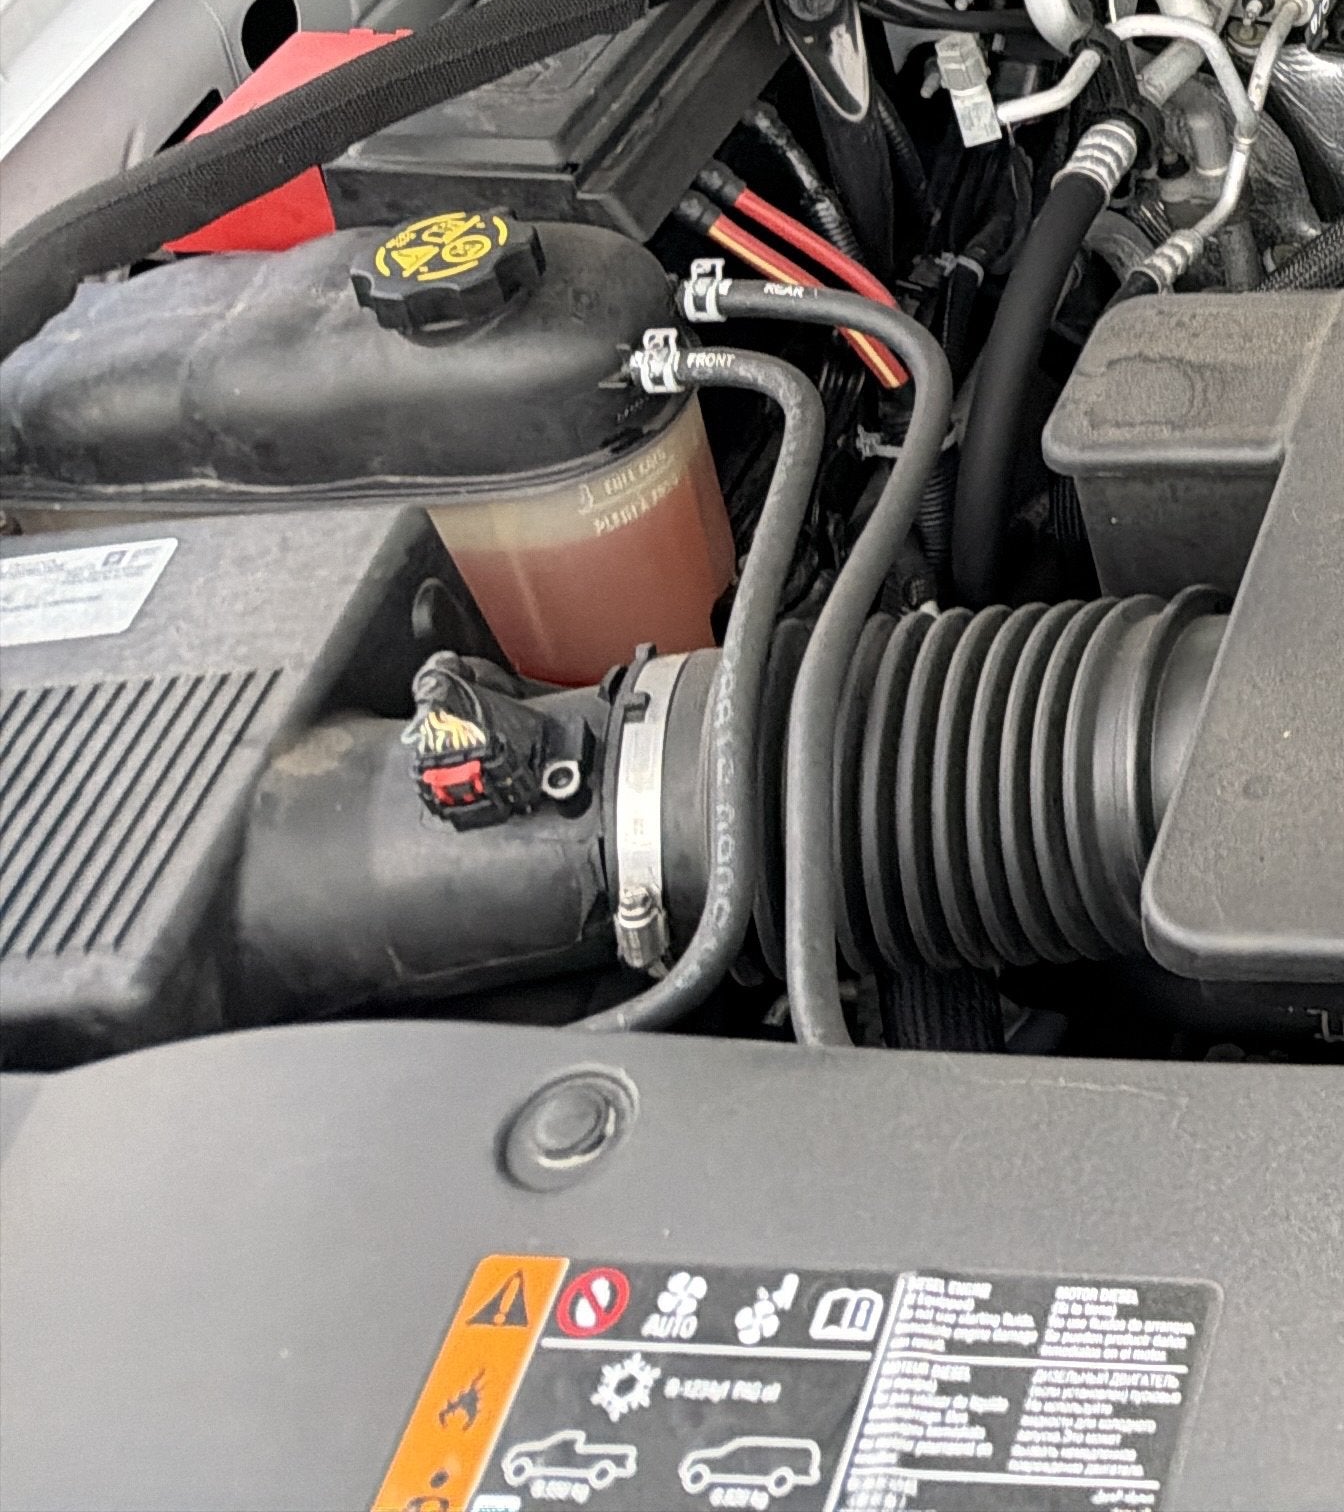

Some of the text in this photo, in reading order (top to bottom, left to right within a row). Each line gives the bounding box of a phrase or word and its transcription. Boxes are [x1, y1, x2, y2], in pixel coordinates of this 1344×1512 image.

[763, 282, 805, 298] REAR
[686, 352, 736, 369] FRONT
[641, 1313, 698, 1339] AUTO
